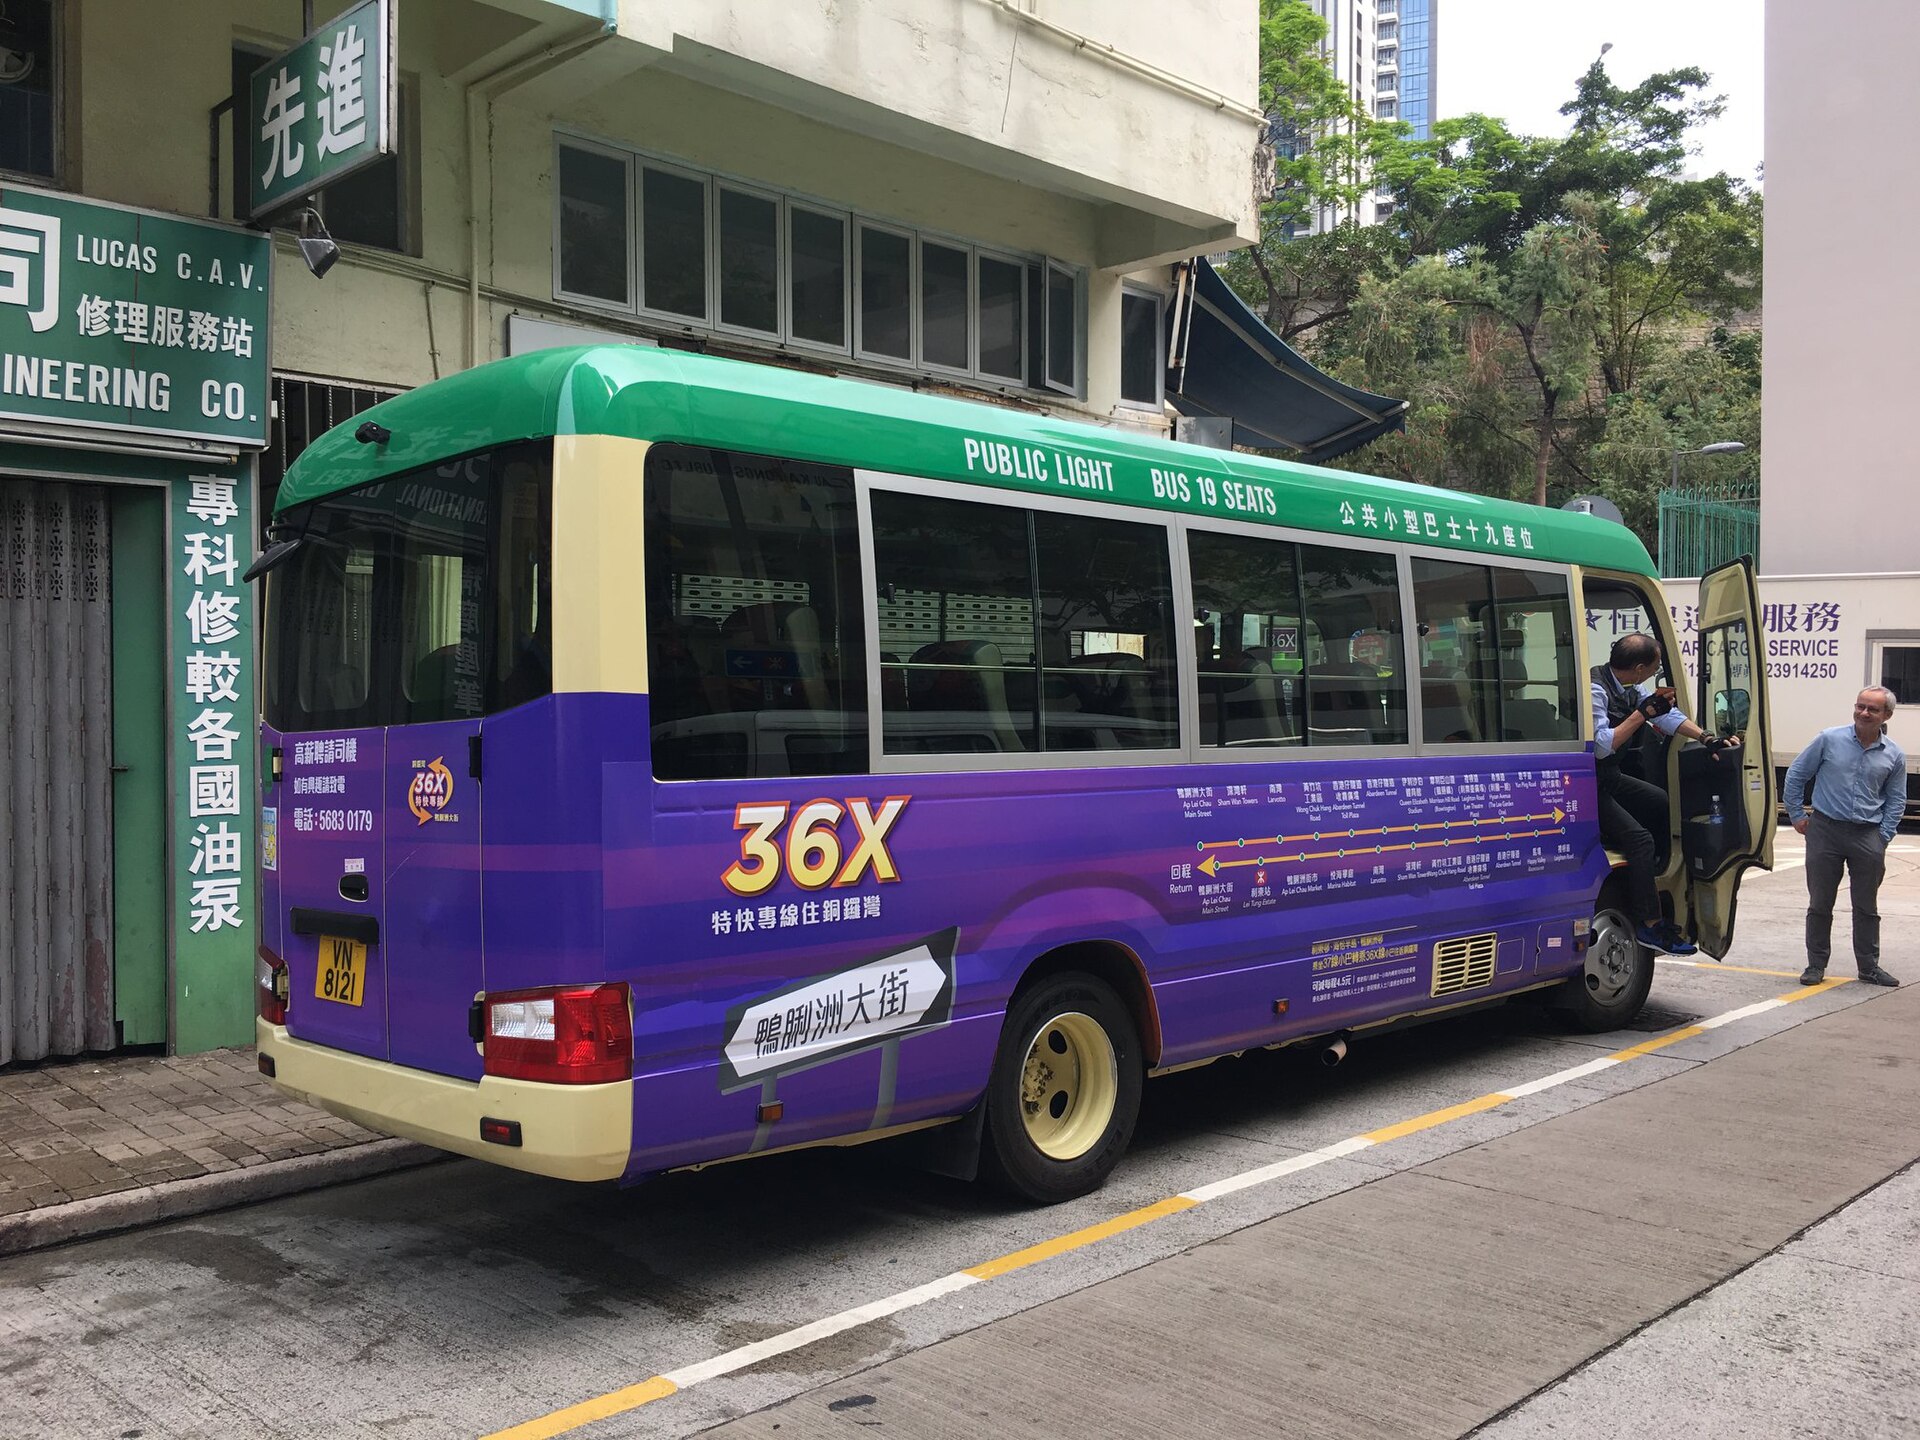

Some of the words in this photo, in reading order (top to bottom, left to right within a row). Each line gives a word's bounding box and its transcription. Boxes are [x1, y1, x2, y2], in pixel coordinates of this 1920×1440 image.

[262, 25, 366, 190] 先進
[77, 234, 157, 274] LUCAS
[177, 253, 263, 292] C.A.V.
[76, 294, 253, 359] 修理服務站
[3, 353, 170, 413] INEERING
[201, 379, 257, 422] CO.
[964, 438, 1048, 482] PUBLIC
[1058, 453, 1113, 492] LIGHT
[1150, 468, 1191, 503] BUS
[1199, 476, 1217, 507] 19
[1223, 481, 1277, 516] SEATS
[1340, 500, 1534, 551] 公共小型巴士十九座位
[1769, 639, 1839, 656] SERVICE
[1767, 663, 1837, 679] 23914250
[184, 473, 243, 935] 專科修較各國油泵
[294, 738, 357, 765] 高薪聘請司機
[414, 772, 446, 794] 36X
[319, 810, 344, 831] 5683
[347, 810, 373, 832] 0179
[720, 795, 912, 897] 36X
[1169, 884, 1192, 894] Return
[1171, 863, 1191, 880] 回程
[333, 940, 353, 970] VN
[324, 968, 355, 1001] 8121
[754, 968, 909, 1059] 鴨脷洲大街
